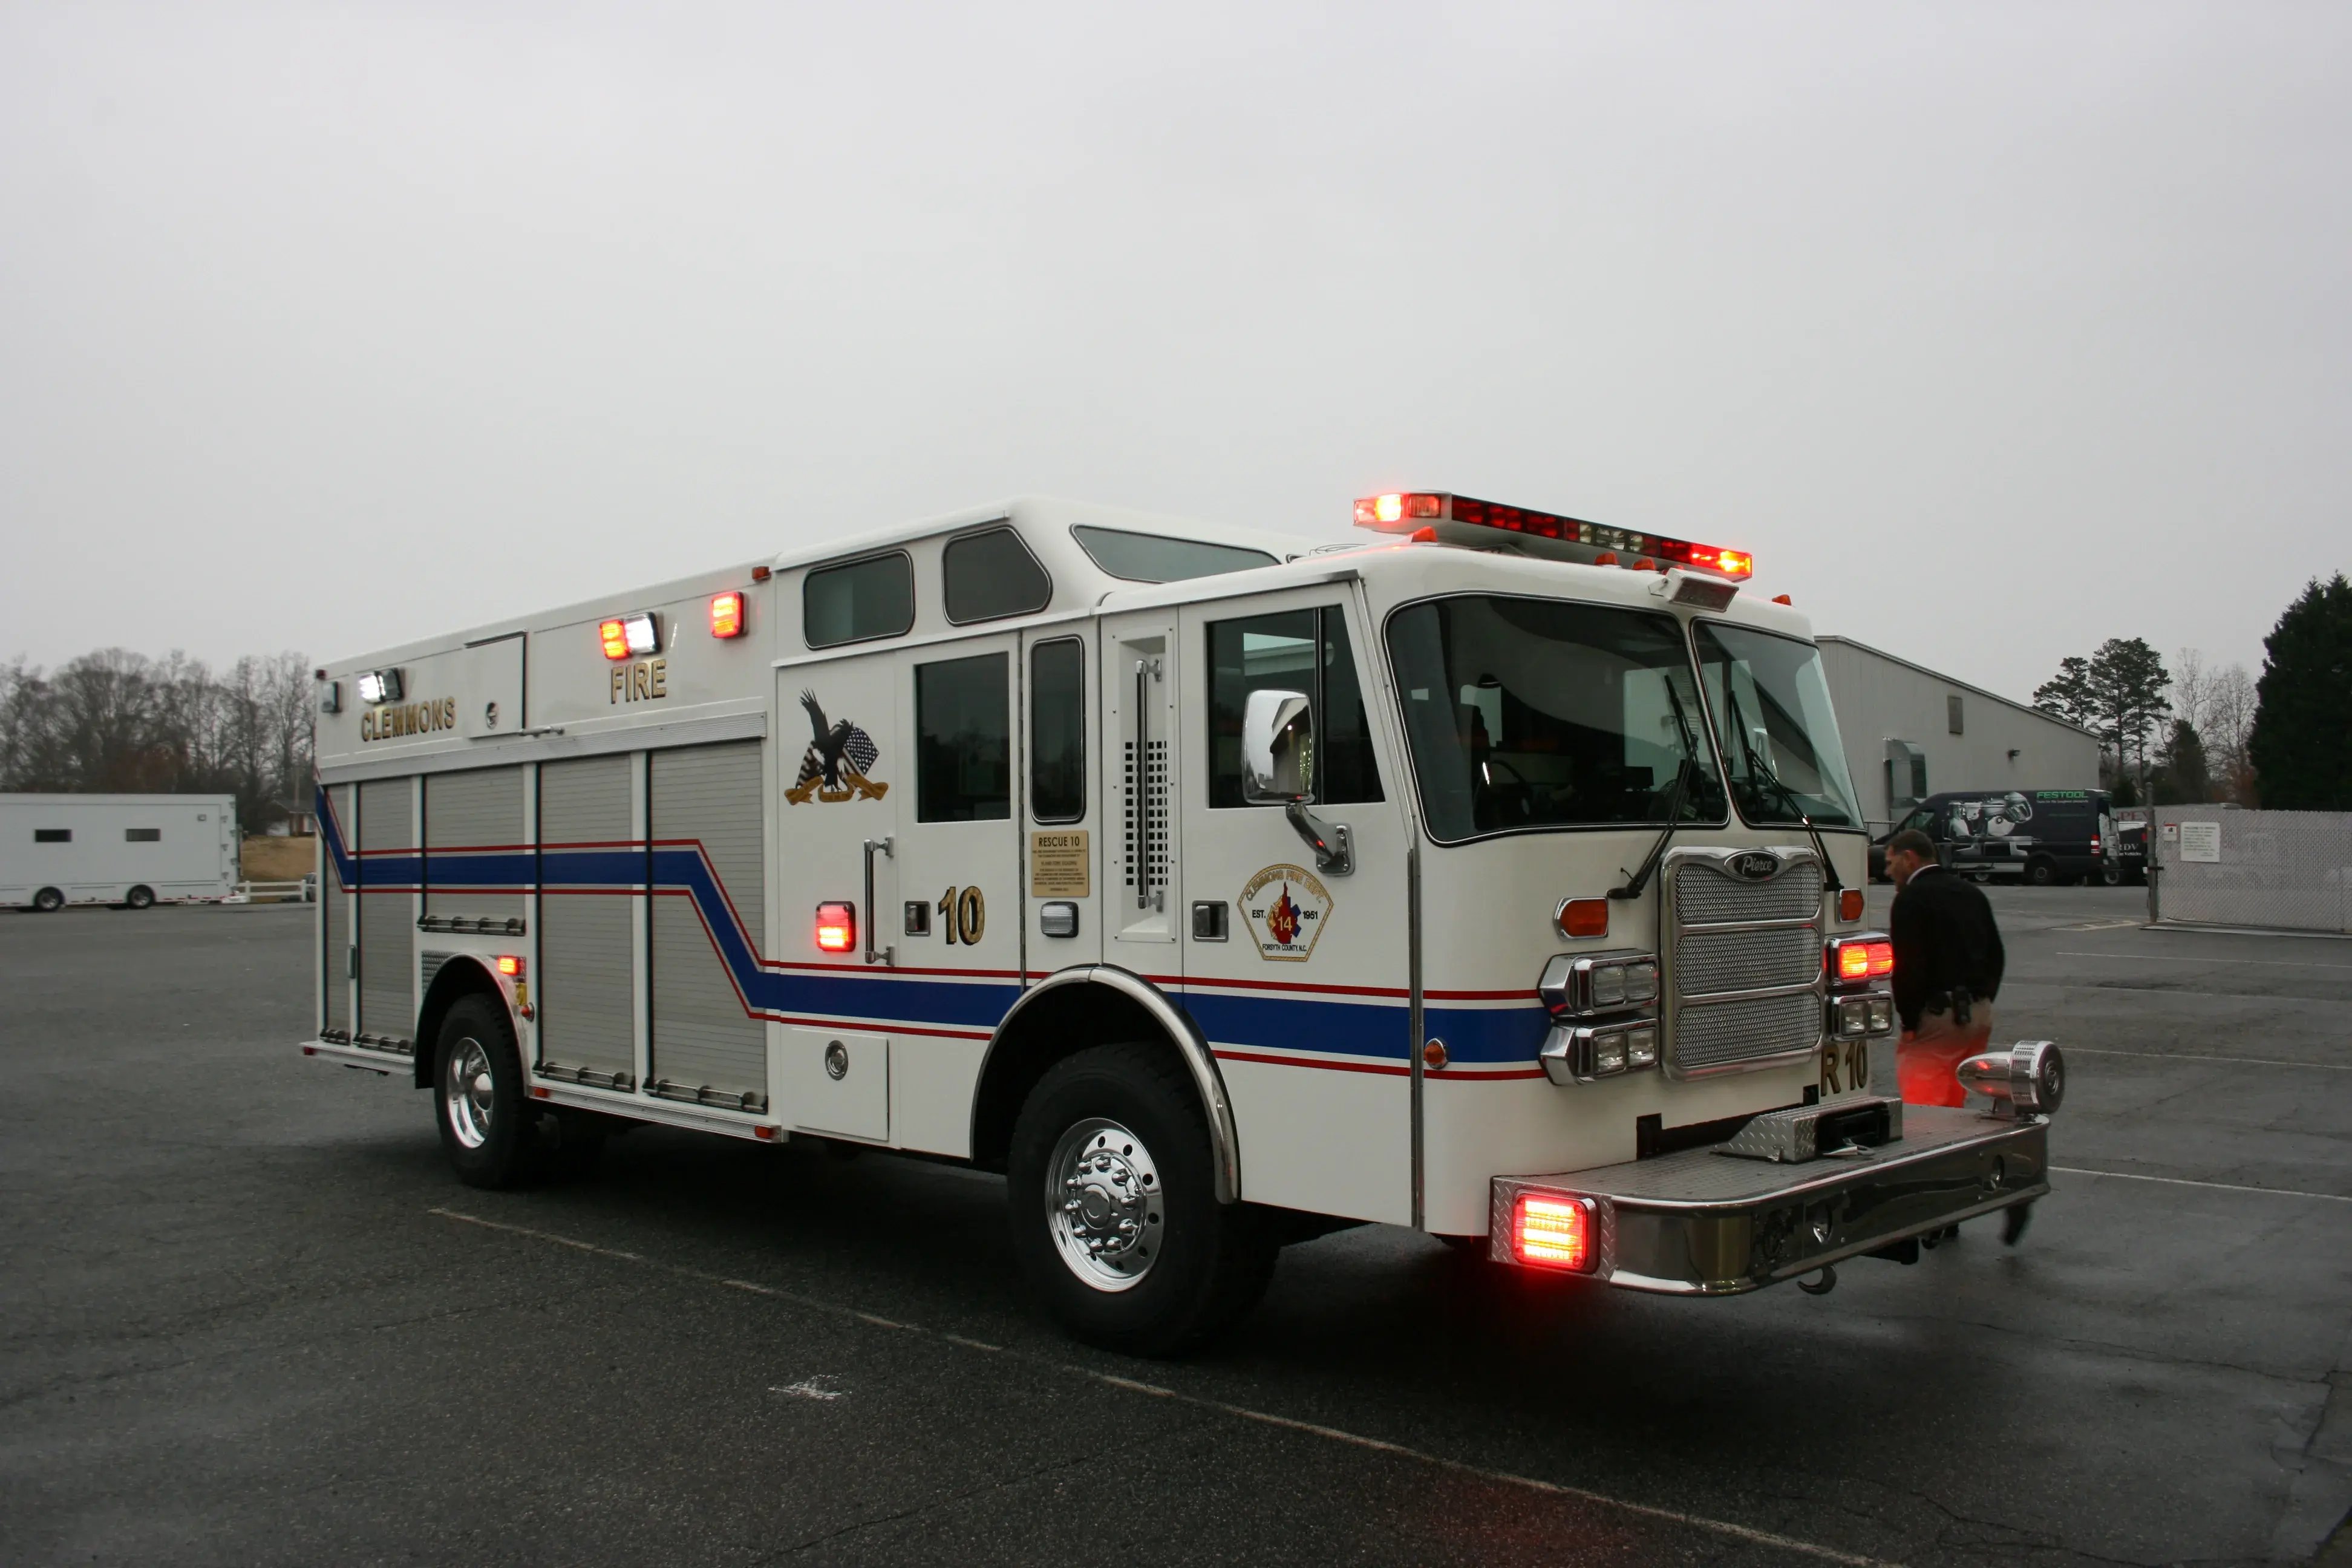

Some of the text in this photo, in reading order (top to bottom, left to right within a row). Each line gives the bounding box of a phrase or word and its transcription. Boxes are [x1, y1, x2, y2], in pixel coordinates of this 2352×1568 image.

[611, 659, 667, 704] FIRE
[362, 696, 456, 742] CLEMMONS
[1039, 836, 1080, 847] RESCUE 10
[1742, 855, 1772, 875] Pierce
[1246, 869, 1284, 901] CLEMMONS
[1286, 870, 1303, 884] FIRE
[938, 886, 985, 946] 10
[1252, 910, 1318, 920] EST. 1951
[1278, 916, 1292, 931] 14
[1820, 1040, 1868, 1097] R 10
